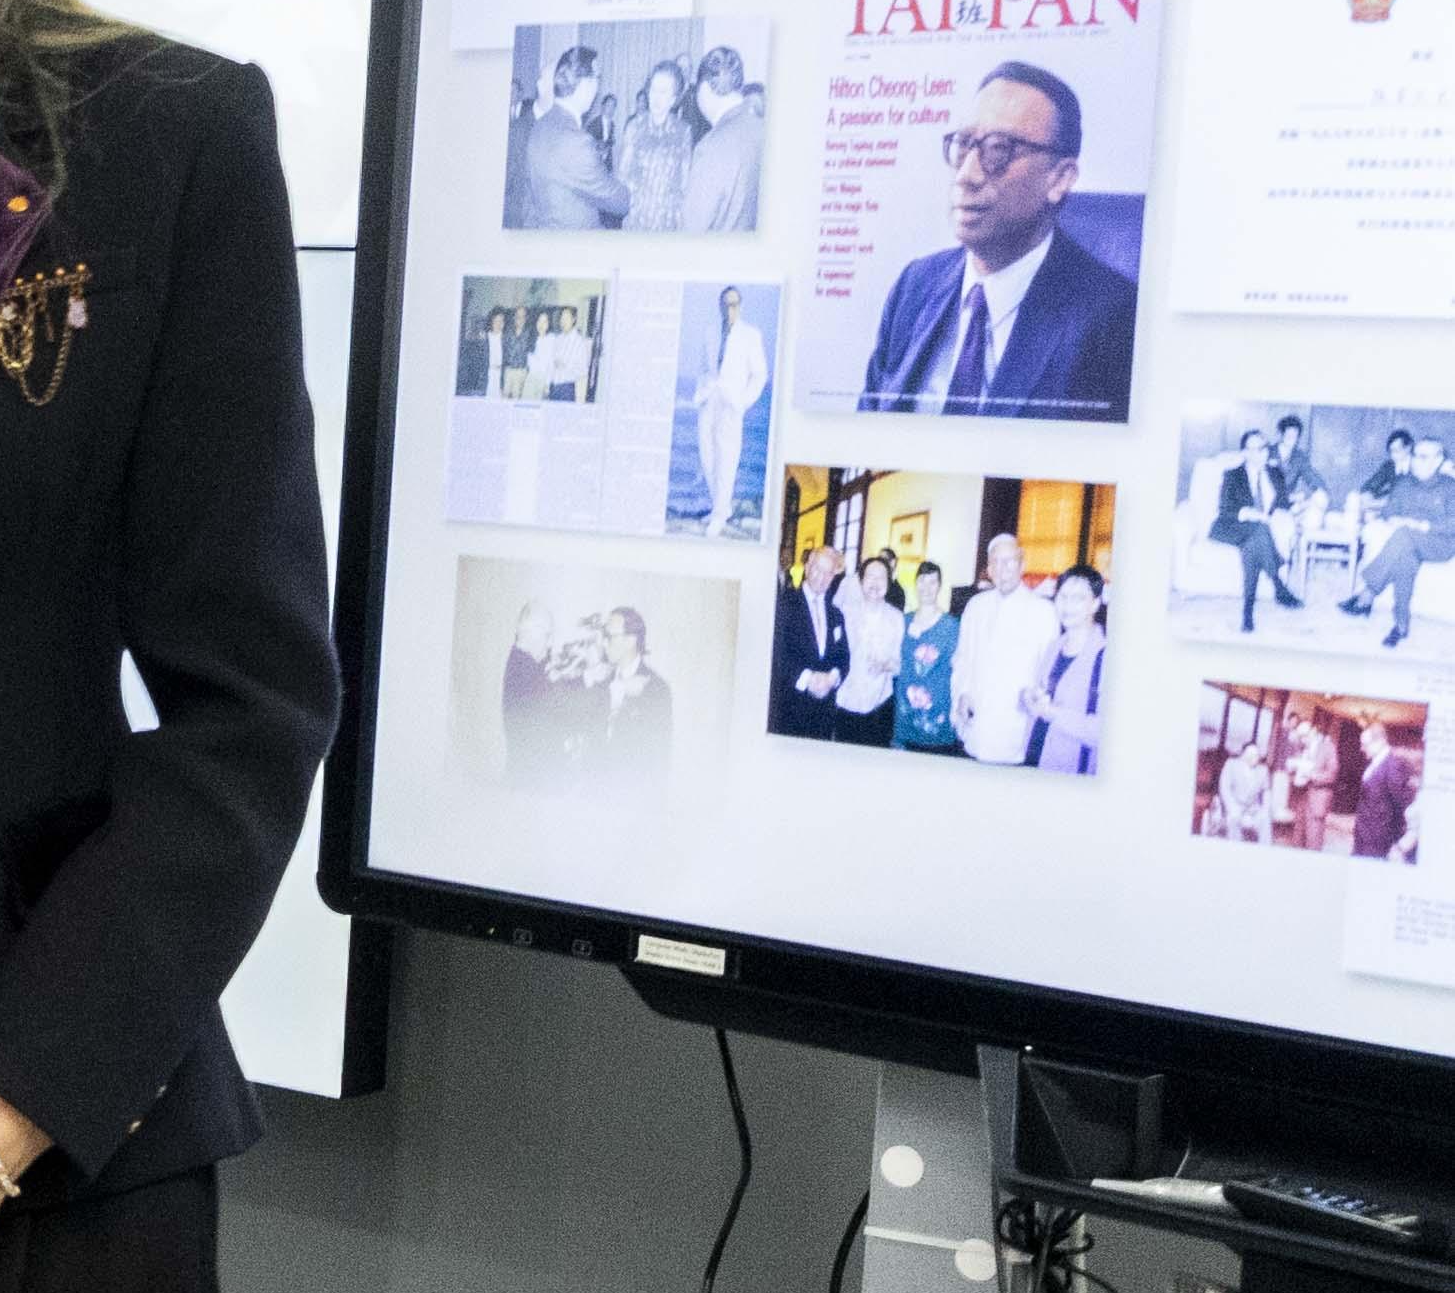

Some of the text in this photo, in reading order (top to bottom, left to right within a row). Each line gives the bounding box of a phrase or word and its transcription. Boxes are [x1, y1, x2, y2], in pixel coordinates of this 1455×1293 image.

[828, 75, 865, 100] Hilton
[826, 107, 952, 130] A passion for culture
